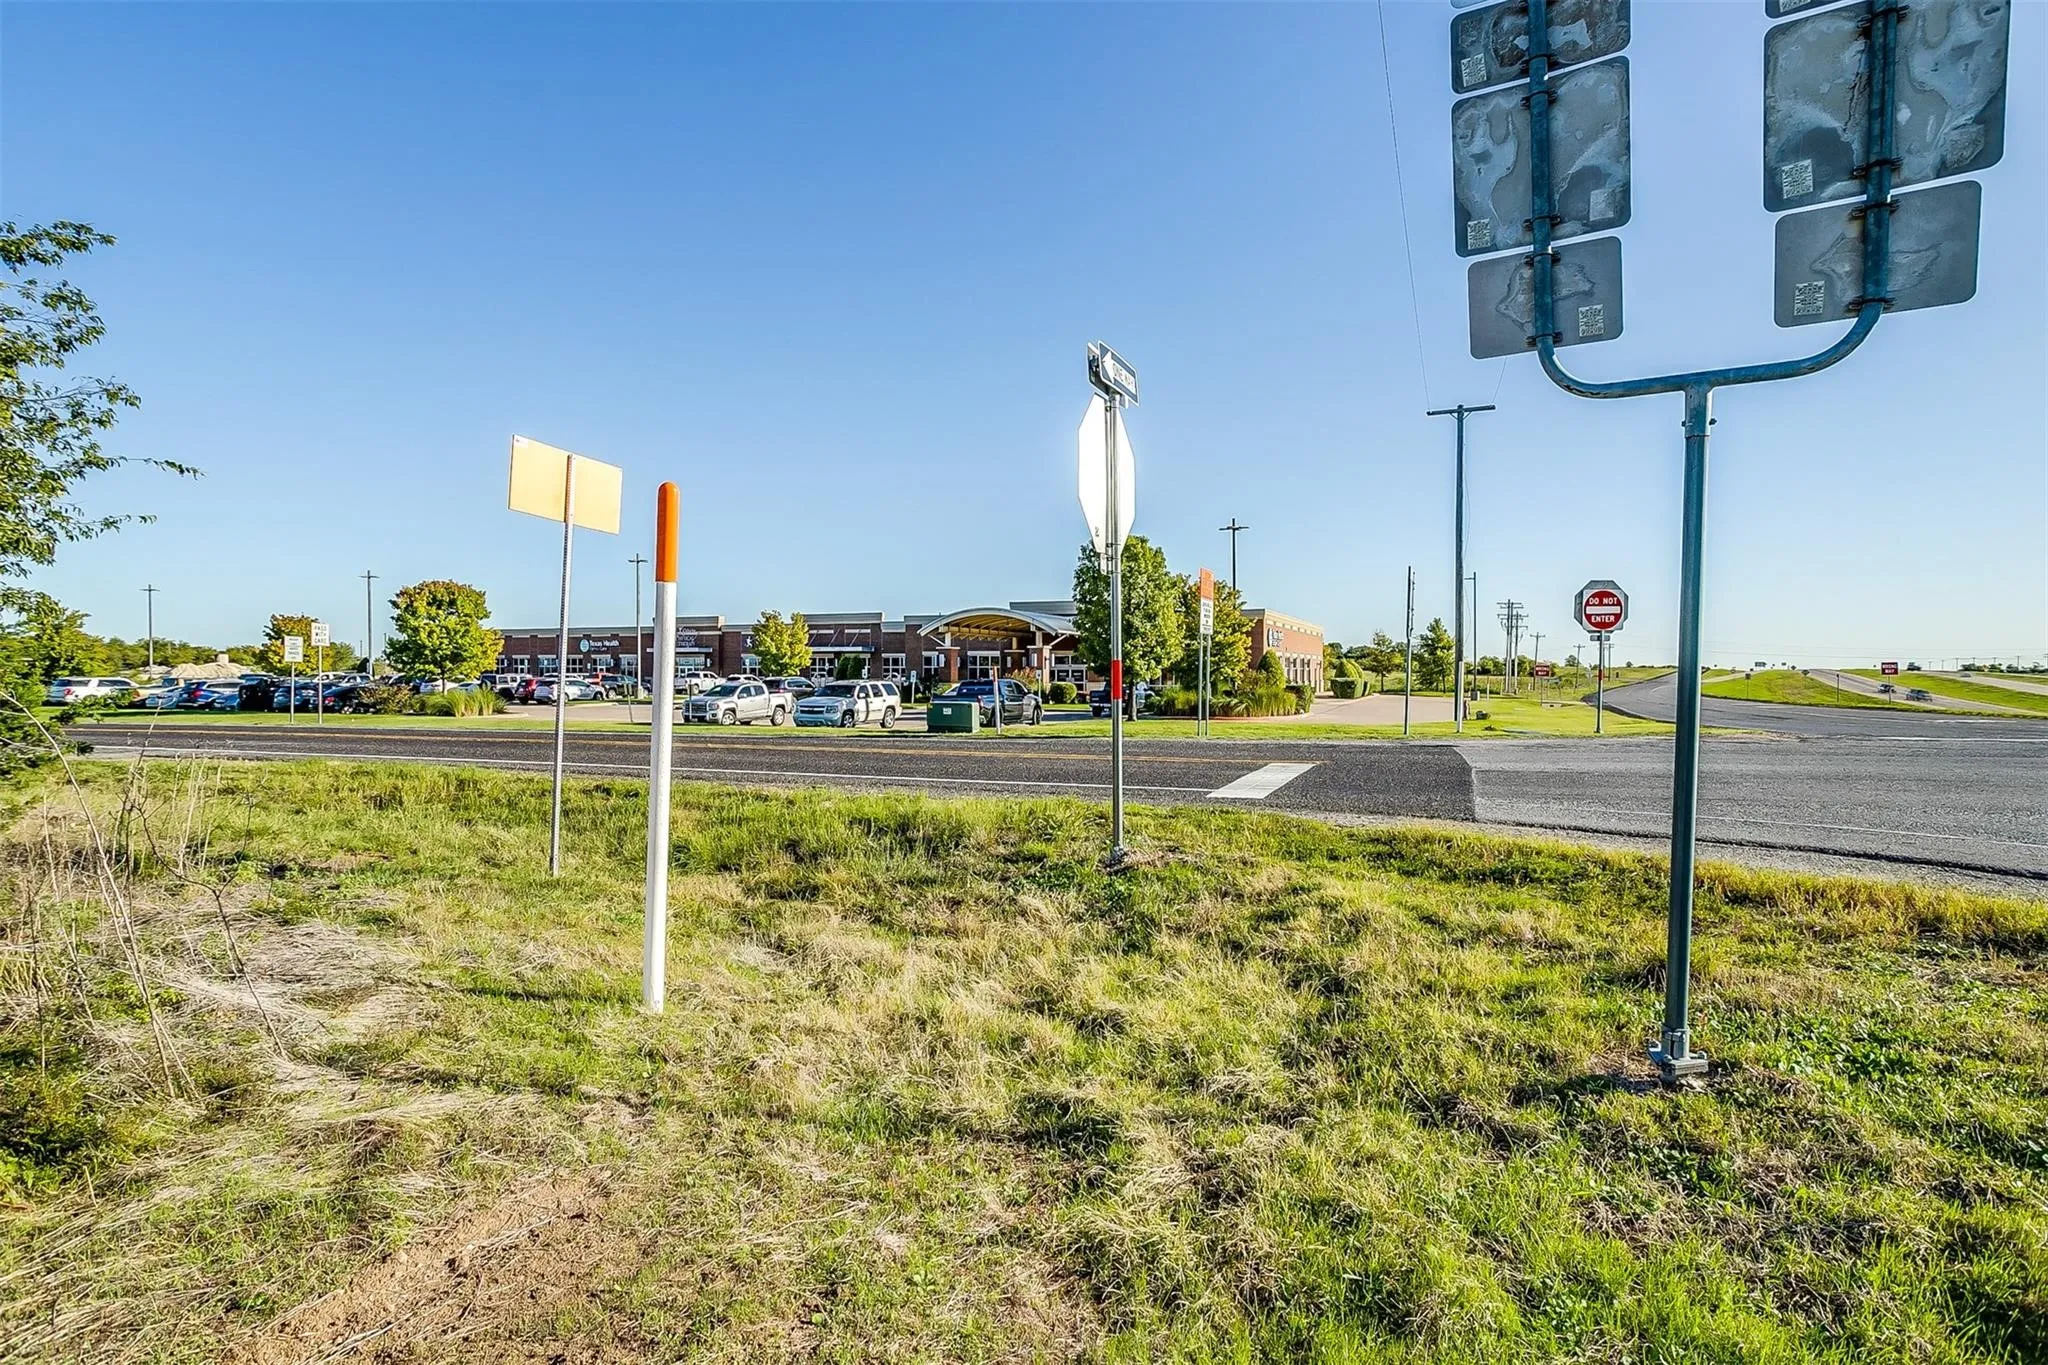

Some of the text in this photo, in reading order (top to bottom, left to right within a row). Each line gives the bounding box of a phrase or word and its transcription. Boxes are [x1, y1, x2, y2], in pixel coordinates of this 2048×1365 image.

[1589, 597, 1618, 605] DO NOT
[1591, 615, 1615, 623] ENTER
